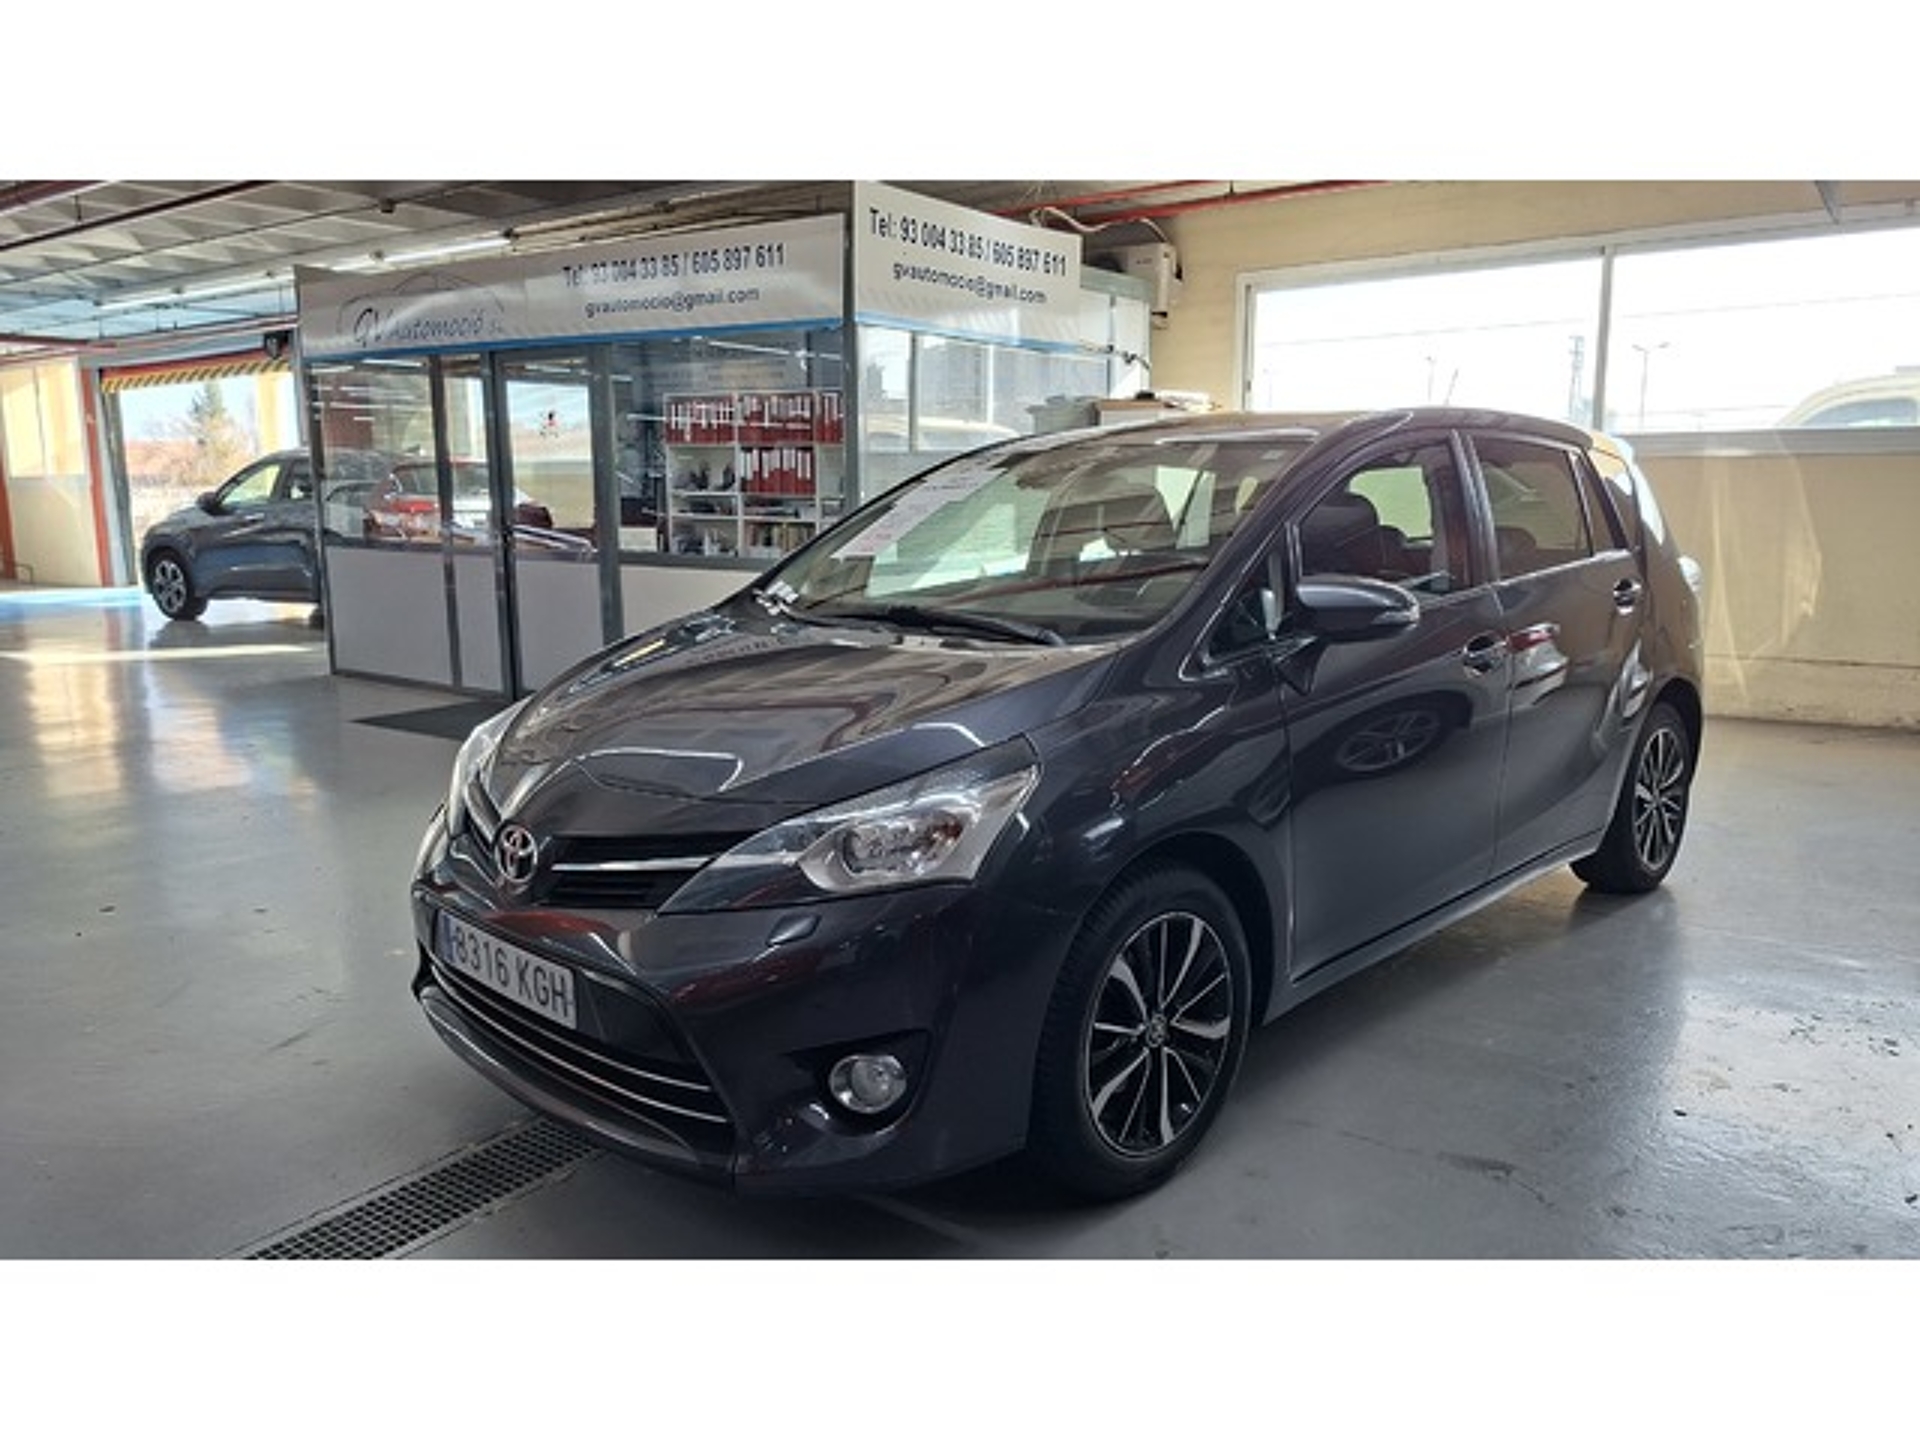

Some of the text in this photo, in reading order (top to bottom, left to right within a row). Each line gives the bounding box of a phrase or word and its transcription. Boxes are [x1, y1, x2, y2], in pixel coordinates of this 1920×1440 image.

[640, 256, 658, 281] 33
[662, 253, 679, 278] 85
[692, 250, 720, 275] 605
[722, 246, 751, 272] 897
[755, 242, 784, 268] 611
[869, 207, 897, 238] Tel:
[901, 215, 917, 244] 93
[921, 222, 946, 249] 004
[950, 229, 965, 256] 33
[1043, 251, 1067, 277] 611
[516, 956, 569, 1018] KGH
